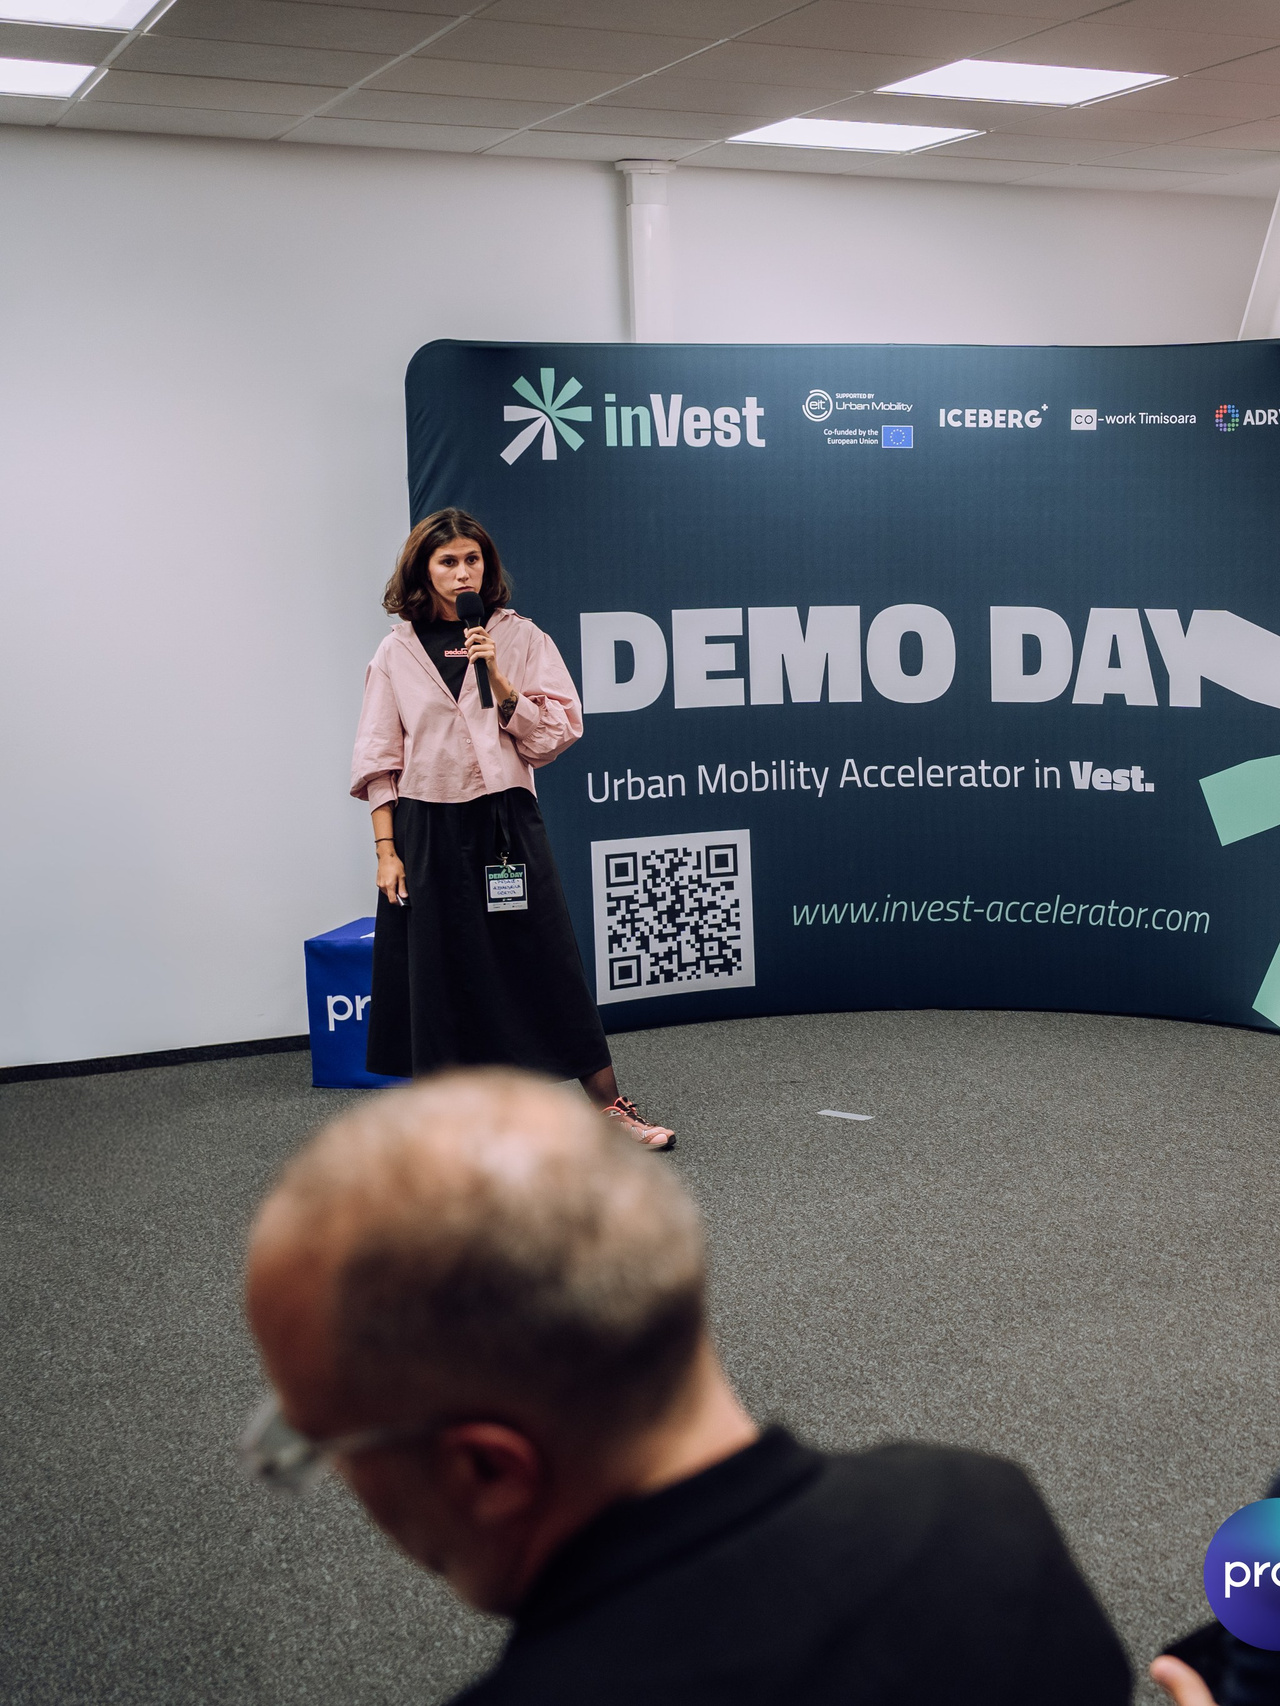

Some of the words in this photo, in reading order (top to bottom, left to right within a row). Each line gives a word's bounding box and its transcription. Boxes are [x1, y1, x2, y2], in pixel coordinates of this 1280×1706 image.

[809, 399, 826, 411] eit
[835, 401, 870, 411] Urban
[871, 401, 914, 413] Mobility
[605, 393, 766, 448] inVest
[1138, 412, 1197, 425] Timisoara
[823, 428, 857, 436] Co-funded
[858, 428, 867, 437] by
[867, 428, 879, 436] the
[827, 437, 858, 446] European
[859, 437, 879, 445] Union
[579, 603, 957, 714] DEMO
[990, 605, 1216, 708] DAY
[587, 768, 687, 803] Urban
[697, 759, 830, 798] Mobility
[839, 756, 1026, 789] Accelerator
[1034, 758, 1061, 789] in
[1069, 760, 1155, 793] Vest.
[792, 893, 1211, 934] www.invest-accelerator.com
